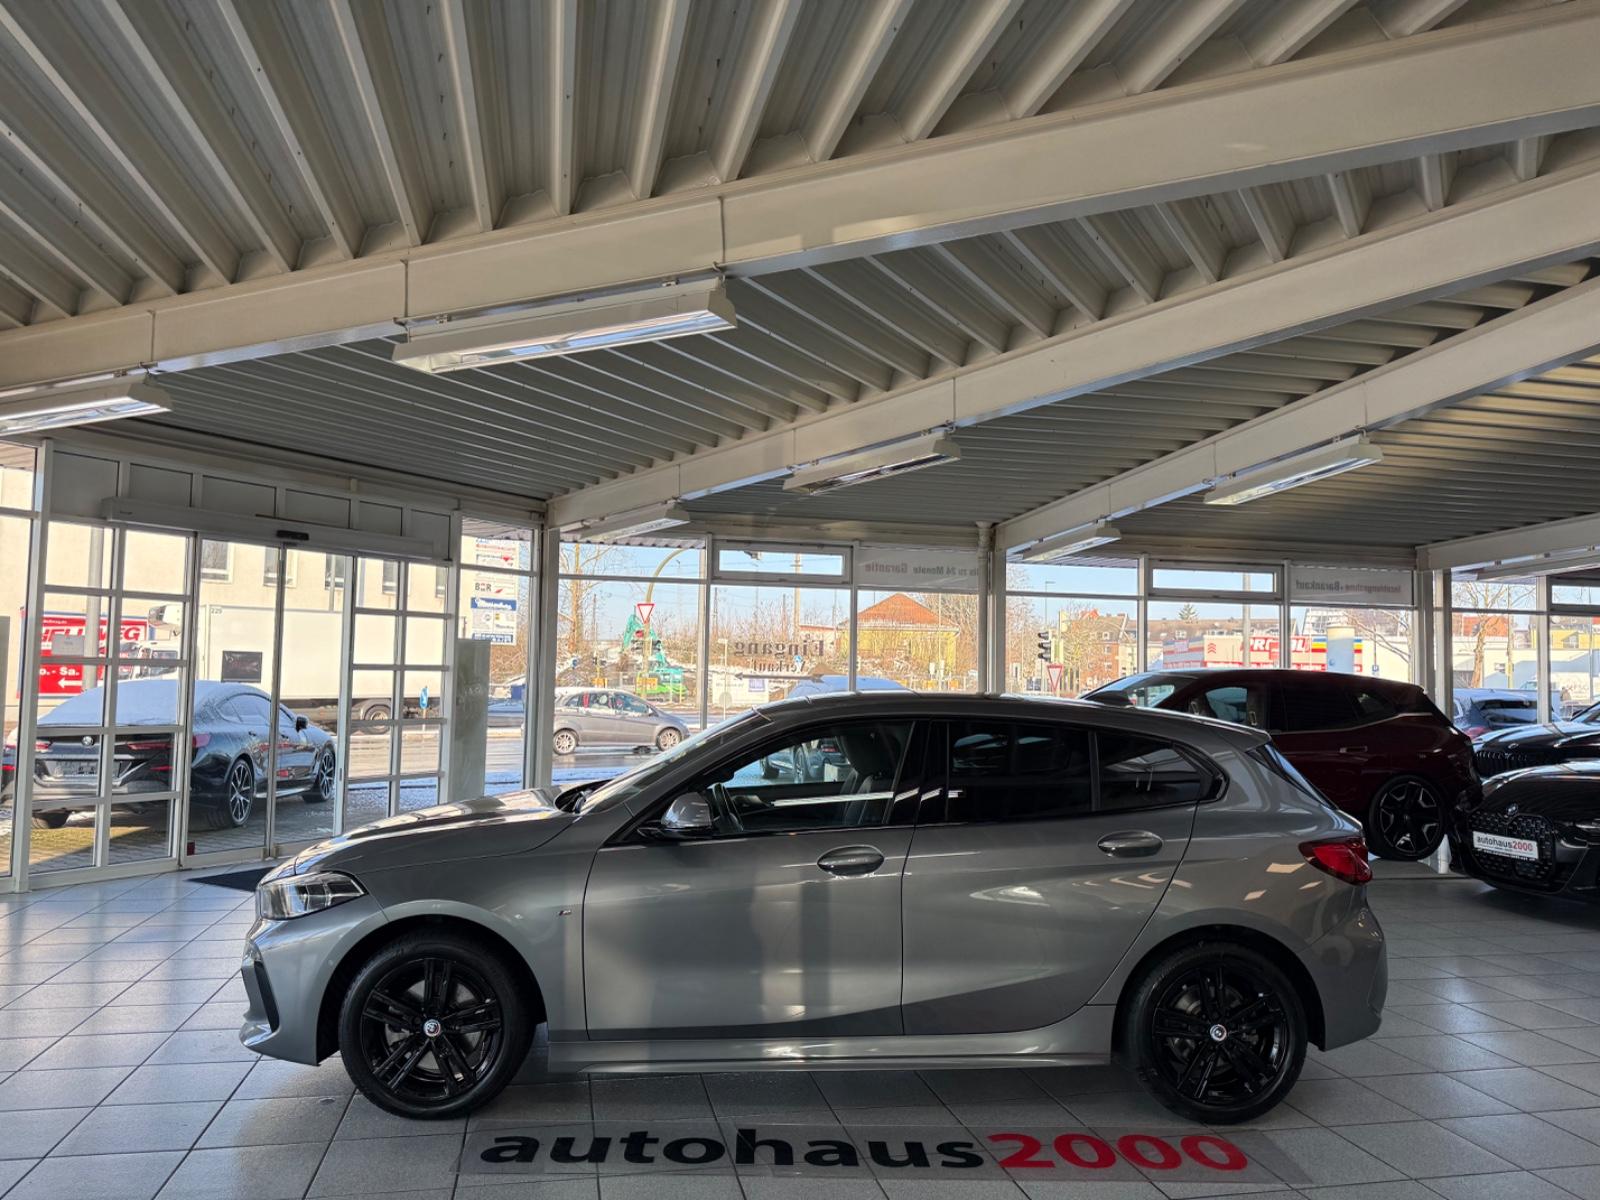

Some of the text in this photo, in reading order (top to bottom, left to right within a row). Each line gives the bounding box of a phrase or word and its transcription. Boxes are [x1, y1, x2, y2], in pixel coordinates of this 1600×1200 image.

[59, 667, 80, 676] Sa.
[1477, 836, 1534, 852] autohaus2000
[480, 1128, 1248, 1170] autohaus2000
